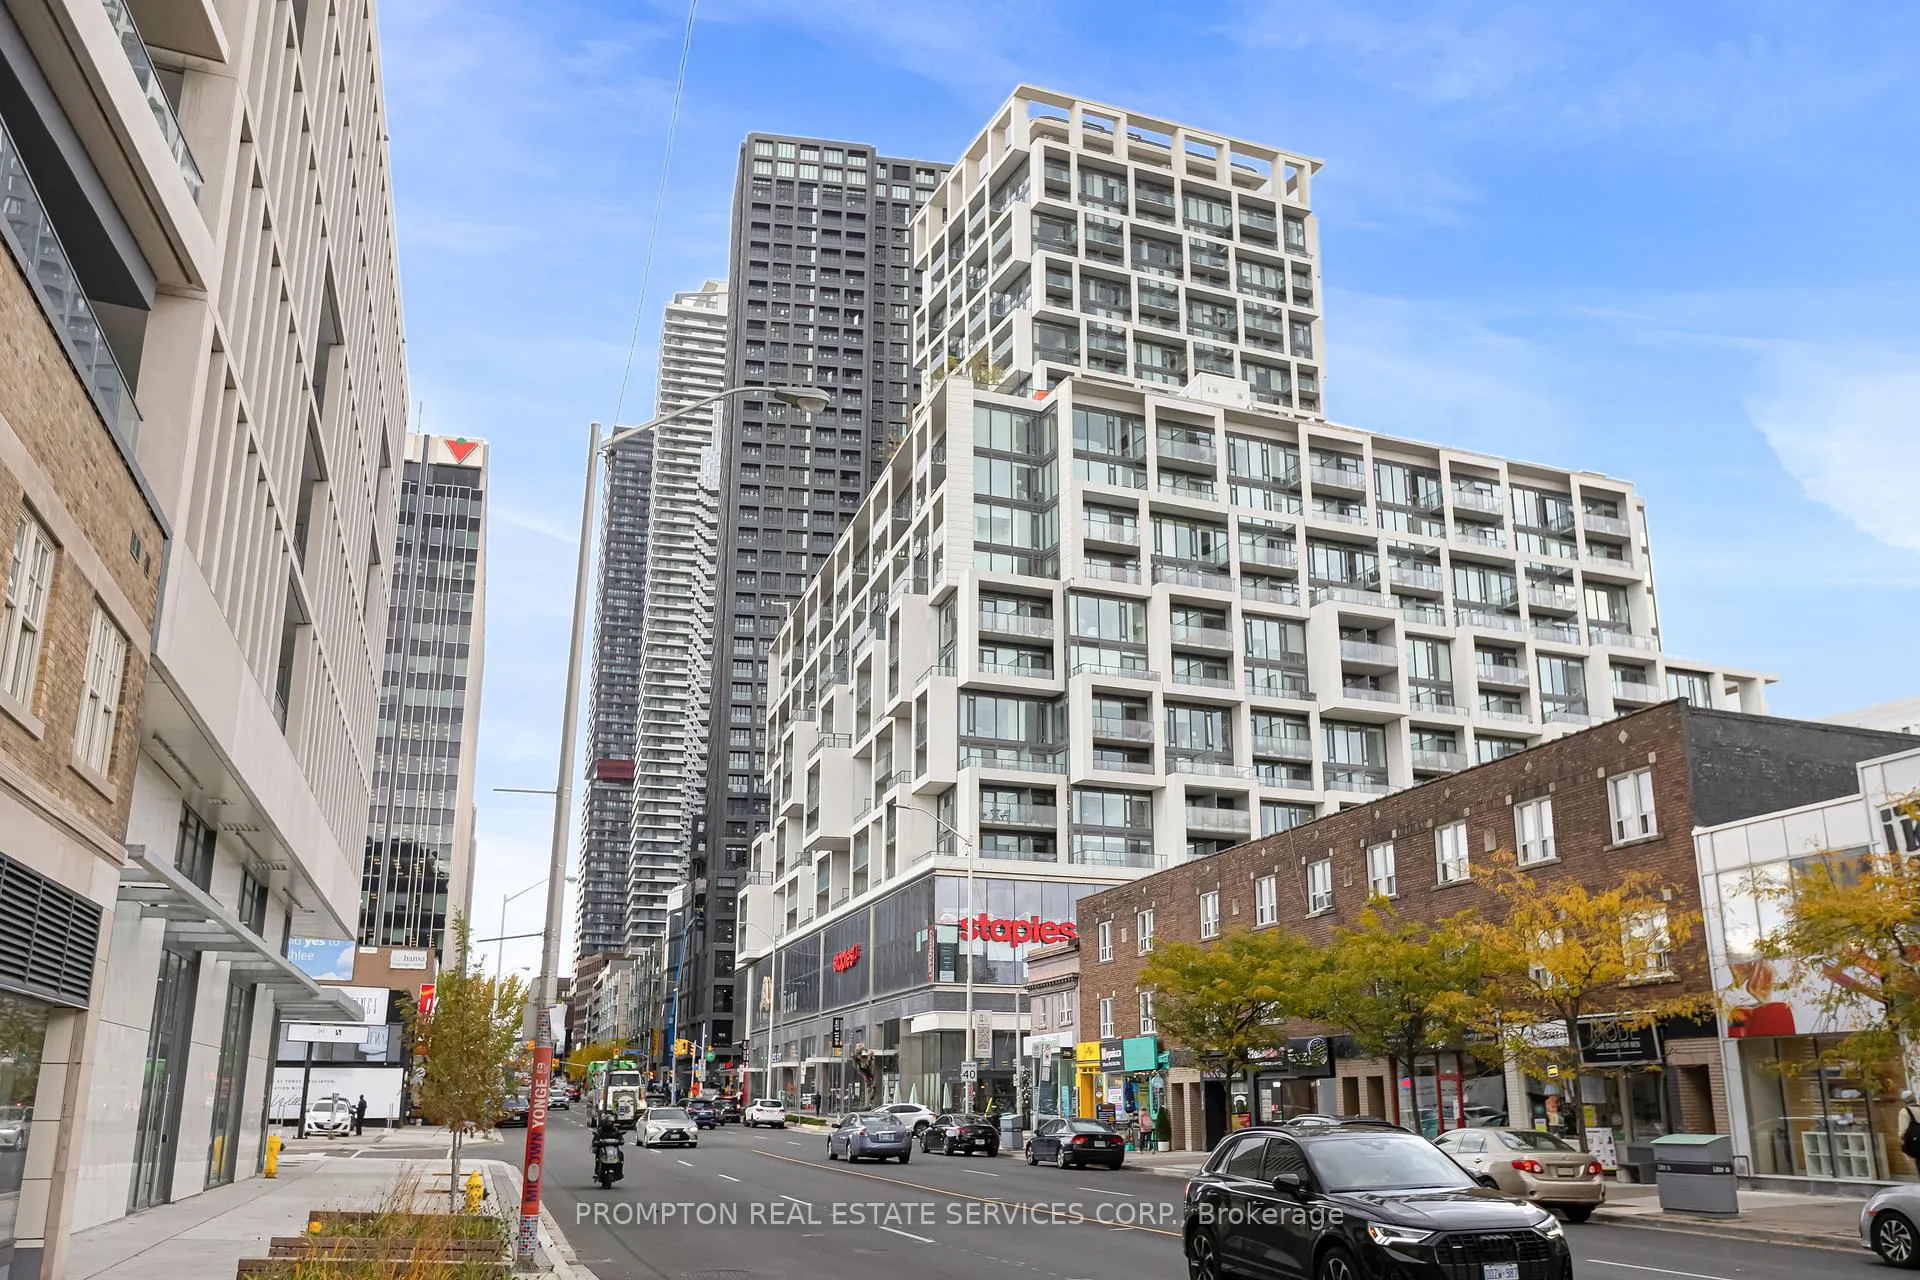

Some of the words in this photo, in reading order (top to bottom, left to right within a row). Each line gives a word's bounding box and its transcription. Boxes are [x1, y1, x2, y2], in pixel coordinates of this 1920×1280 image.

[960, 912, 1077, 948] staples
[304, 938, 326, 948] yes
[962, 1069, 976, 1079] 40
[531, 1079, 548, 1129] YONGE
